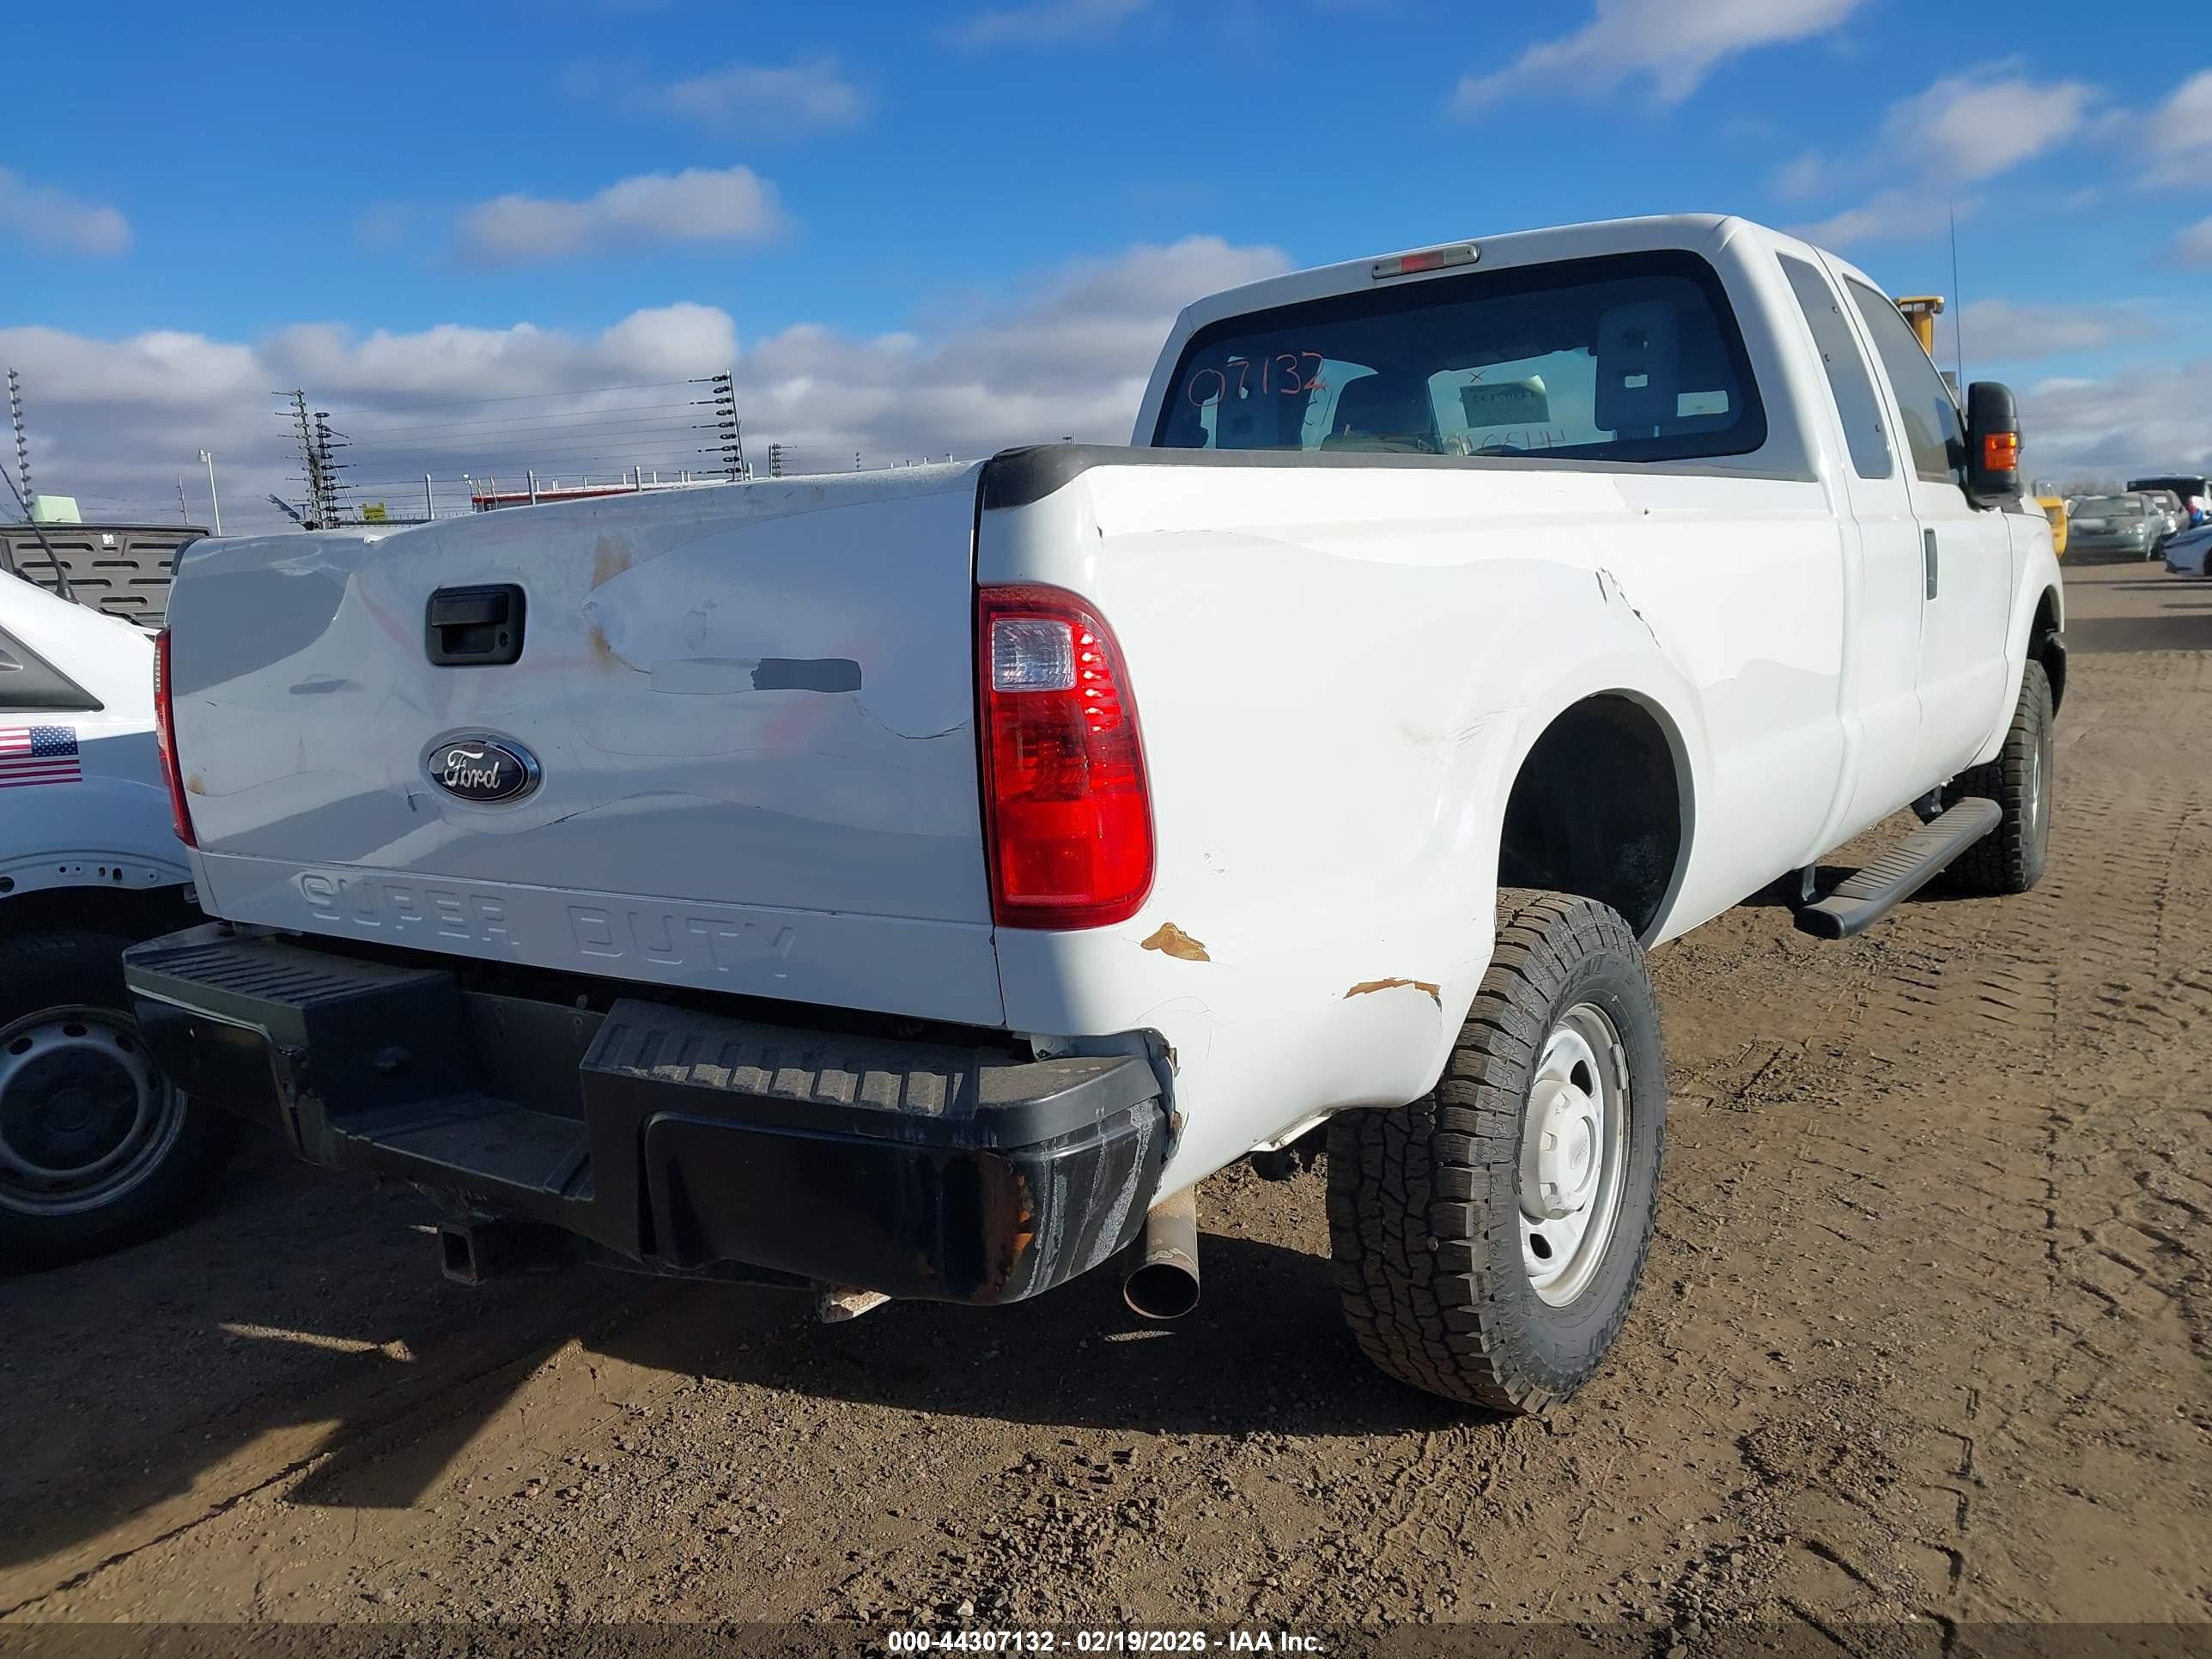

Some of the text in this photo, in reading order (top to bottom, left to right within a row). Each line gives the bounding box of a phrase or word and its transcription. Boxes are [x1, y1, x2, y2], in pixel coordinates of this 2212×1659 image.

[1188, 351, 1328, 407] 07132
[442, 750, 501, 788] Ford
[296, 872, 795, 978] SUPER DUTY
